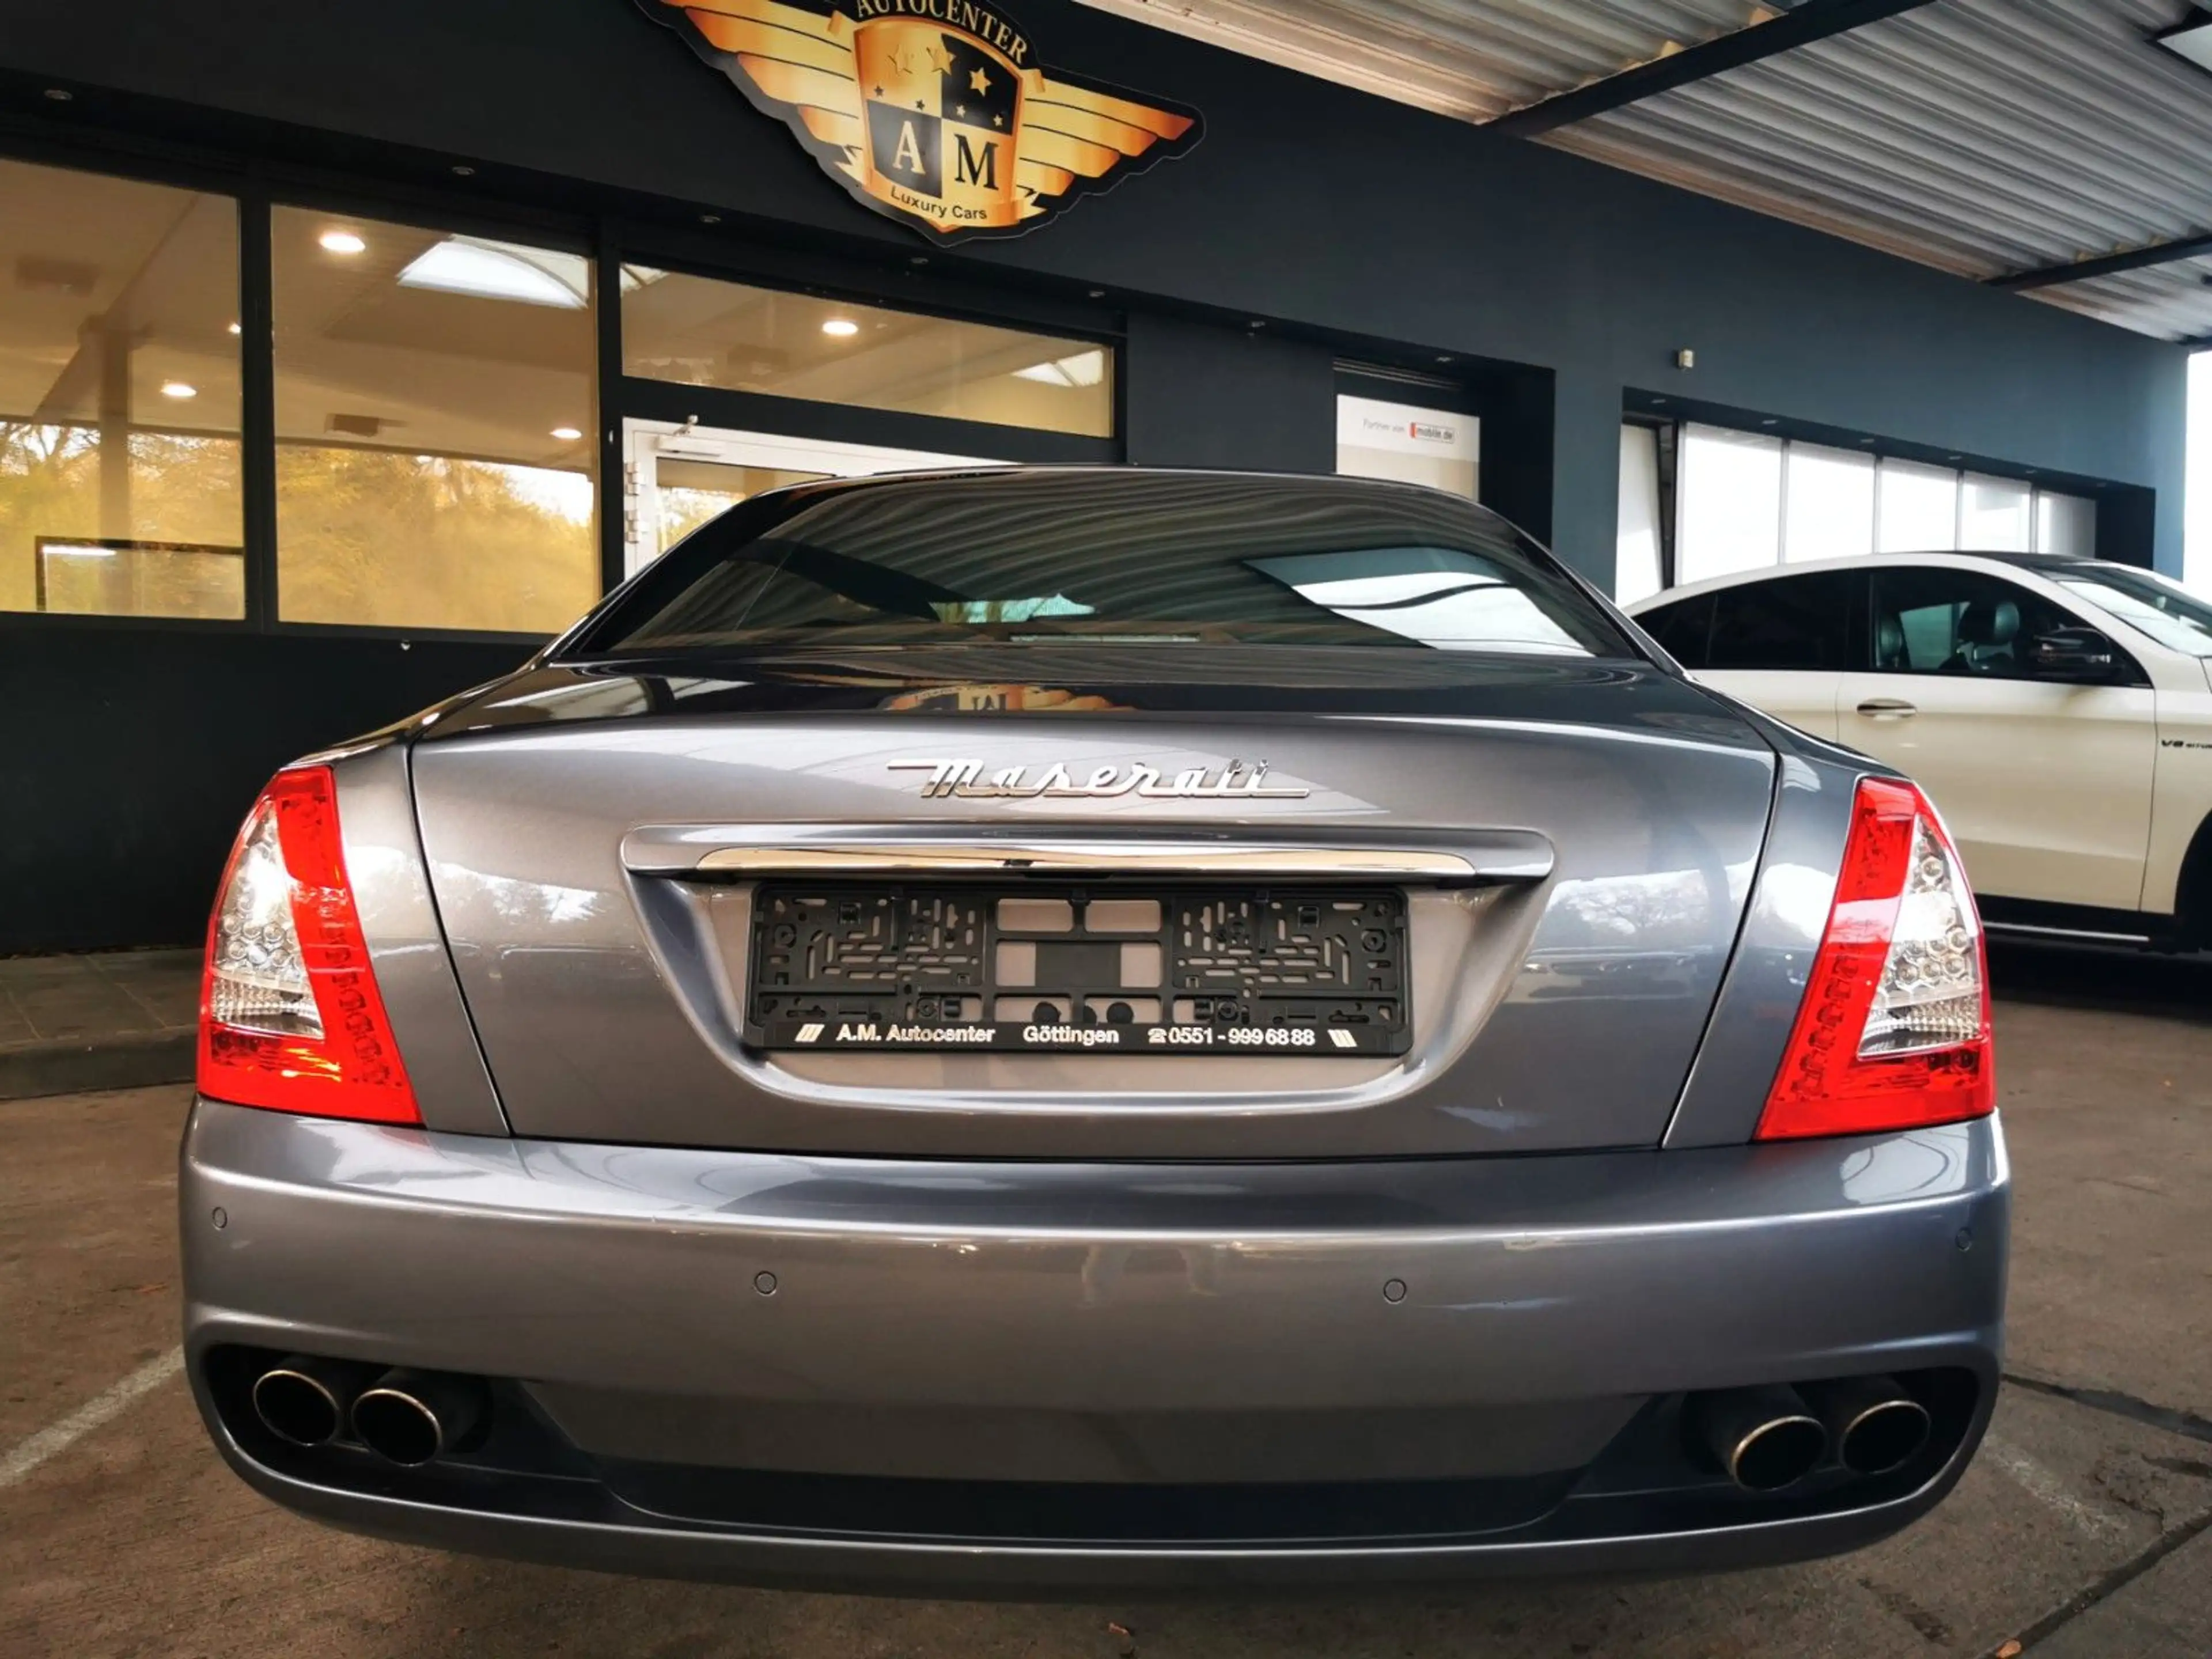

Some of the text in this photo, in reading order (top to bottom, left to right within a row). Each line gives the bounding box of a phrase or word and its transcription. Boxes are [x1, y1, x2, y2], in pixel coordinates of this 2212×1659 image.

[893, 120, 999, 190] A M
[891, 184, 987, 219] Luxury Cars
[887, 757, 1310, 797] Maserati
[836, 1024, 882, 1041] A.M.
[885, 1024, 996, 1043] Autocenter
[1022, 1025, 1119, 1046] Göttingen
